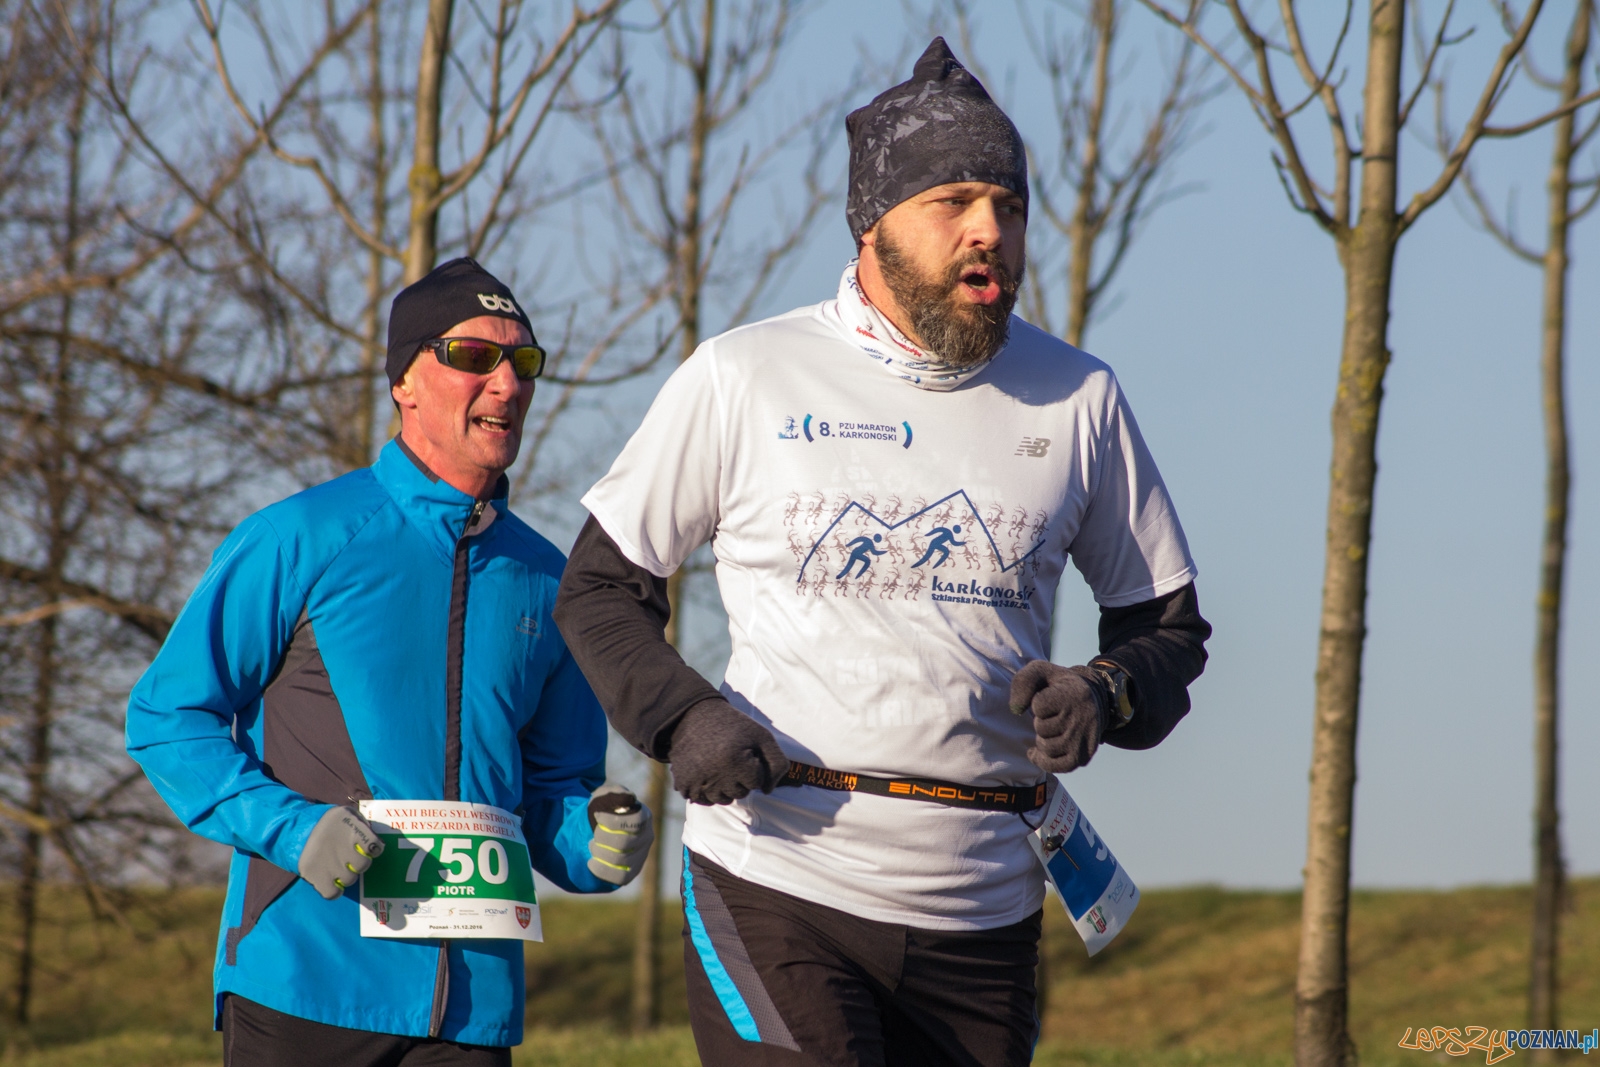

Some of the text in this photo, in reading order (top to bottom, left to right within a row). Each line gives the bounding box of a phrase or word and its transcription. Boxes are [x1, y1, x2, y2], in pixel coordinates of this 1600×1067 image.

[819, 421, 836, 438] 8.
[839, 422, 897, 433] PZU MARATON
[839, 430, 897, 442] KARKONOSKI
[931, 593, 971, 605] Szklarska
[888, 781, 1016, 805] ENDUTRI
[385, 808, 517, 828] XXXII BIEG SYLWESTROWY
[391, 821, 516, 838] IM. RYSZARDA BURGIELA
[397, 837, 509, 885] 750
[437, 885, 475, 896] PIOTR
